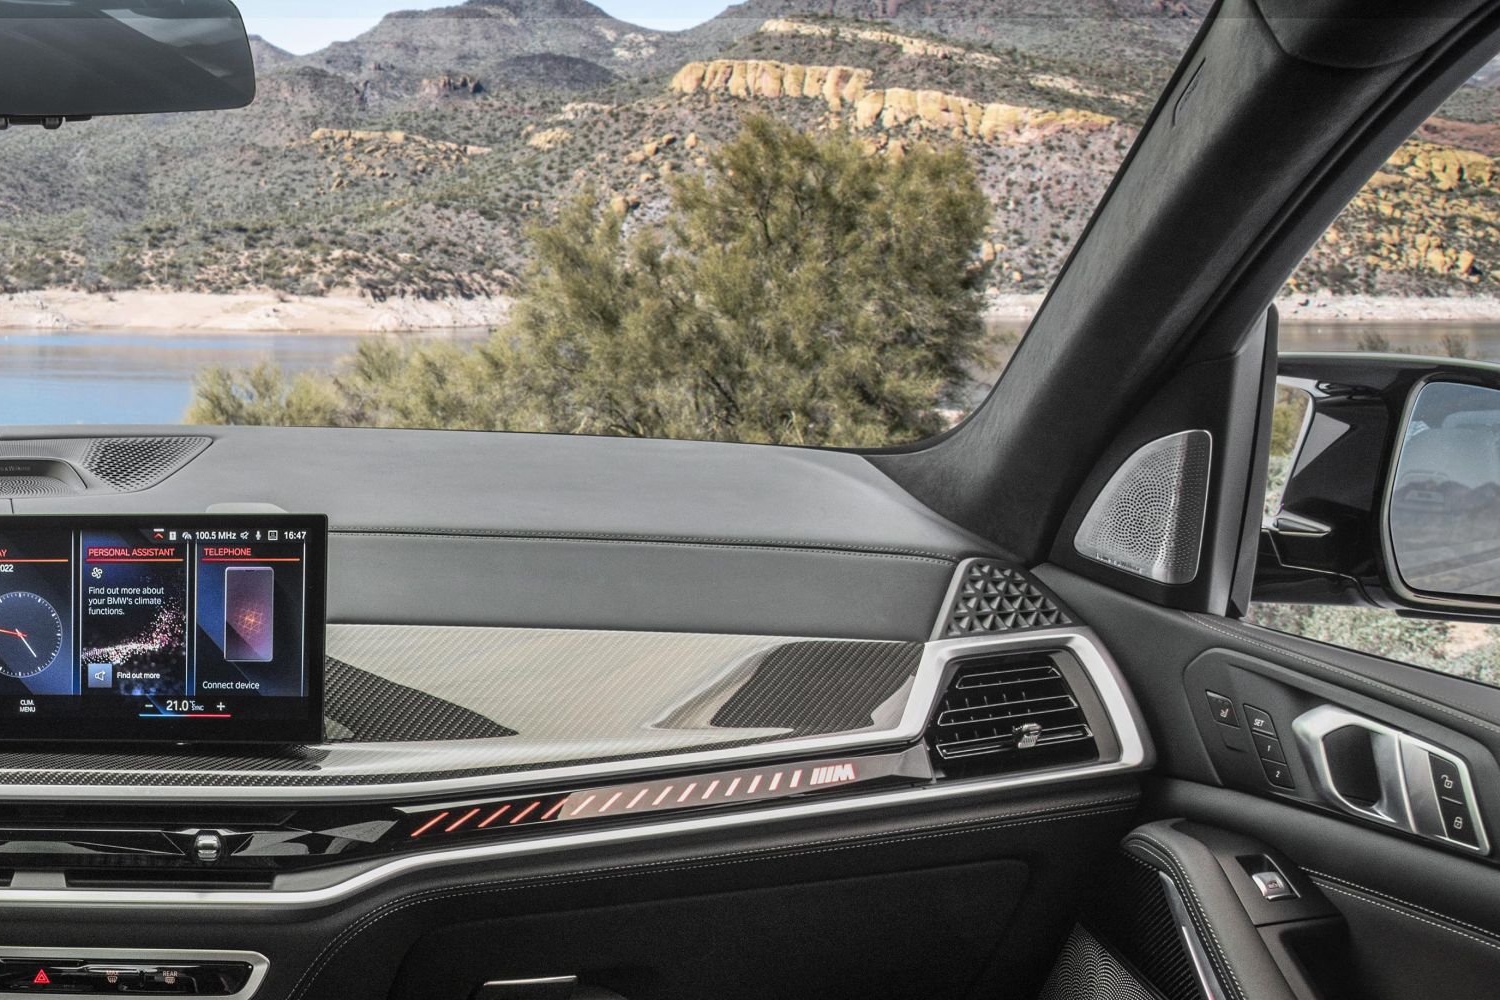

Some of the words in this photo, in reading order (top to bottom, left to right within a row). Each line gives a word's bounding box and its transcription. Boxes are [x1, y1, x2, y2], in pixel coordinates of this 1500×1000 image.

[195, 531, 216, 540] 100.5
[218, 531, 237, 540] MHz
[283, 531, 307, 540] 16:47
[88, 548, 130, 557] PERSONAL
[132, 548, 175, 557] ASSISTANT
[203, 548, 252, 556] TELEPHONE
[88, 586, 105, 595] Find
[107, 587, 118, 595] out
[142, 586, 165, 595] about
[88, 598, 105, 606] your
[107, 597, 133, 605] BMW's
[134, 597, 162, 605] climate
[88, 607, 125, 615] functions.
[116, 671, 131, 679] Find
[202, 681, 233, 689] Connect
[235, 681, 260, 689] device
[166, 700, 189, 711] 21.0
[1253, 718, 1265, 727] SET
[1275, 770, 1281, 778] 2
